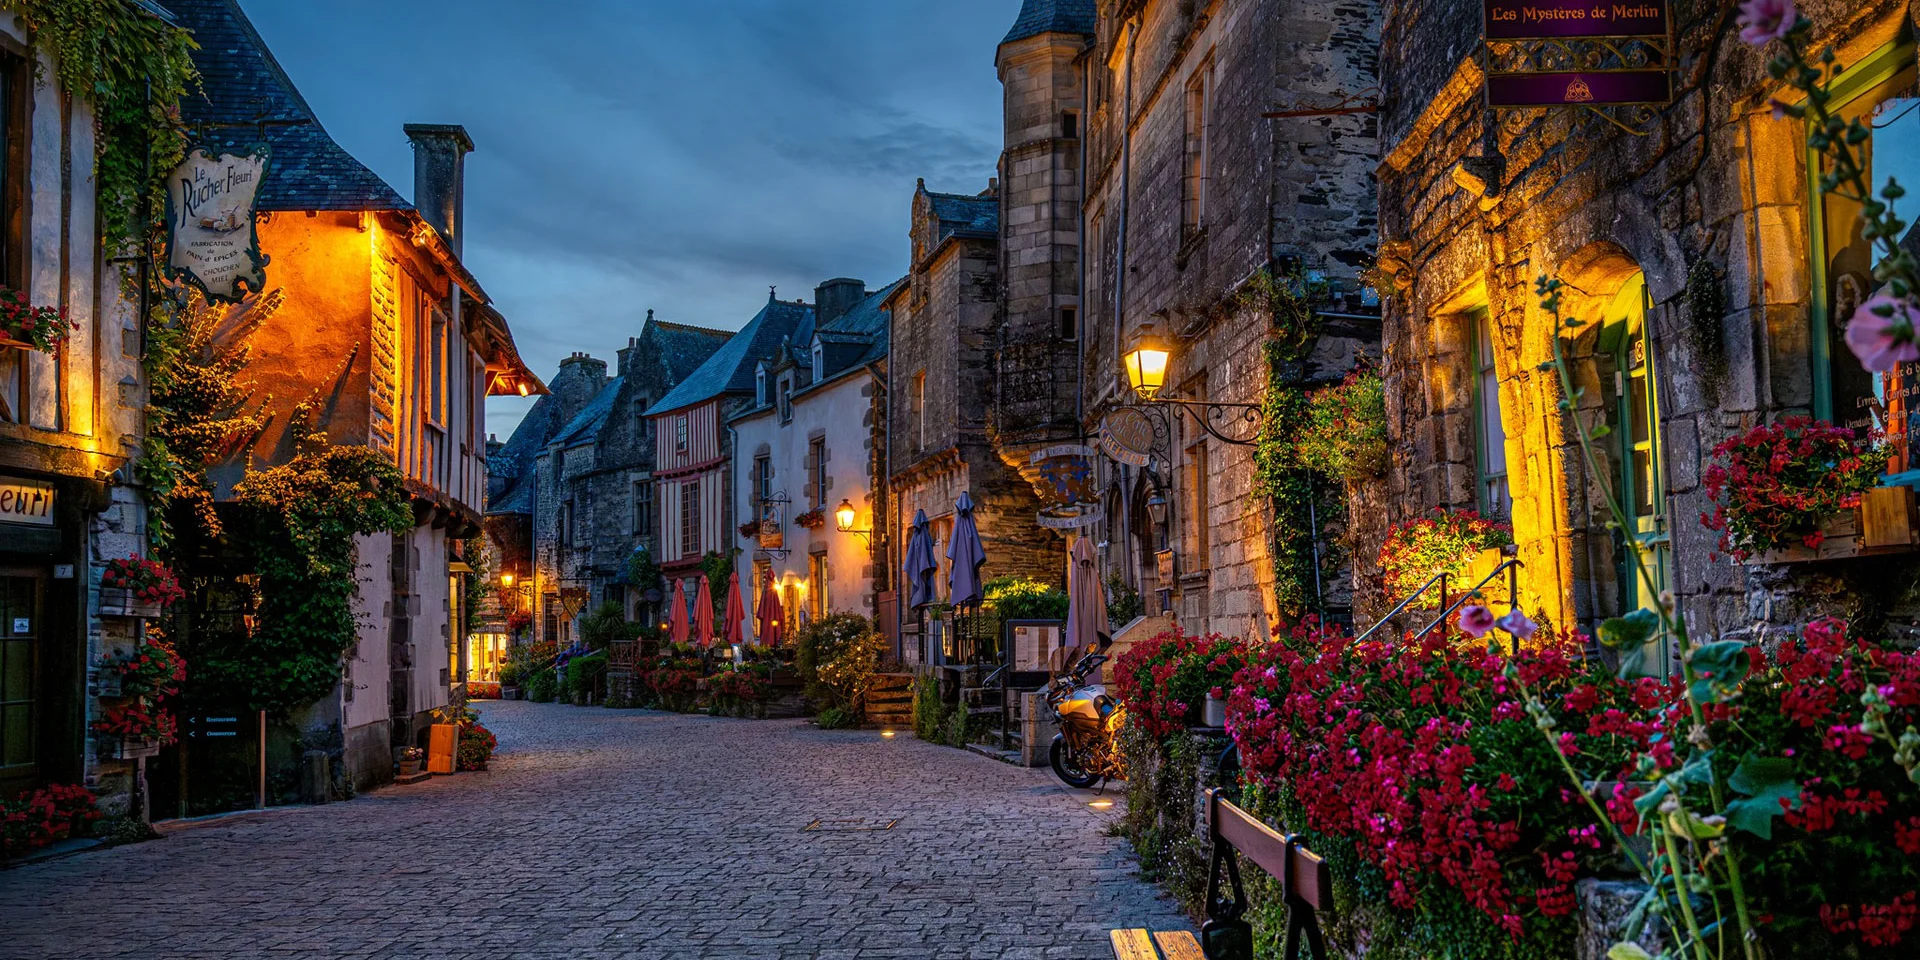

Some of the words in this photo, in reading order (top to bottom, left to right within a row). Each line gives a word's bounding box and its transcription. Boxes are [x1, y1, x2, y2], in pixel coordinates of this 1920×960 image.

[1492, 7, 1517, 21] Les
[1522, 6, 1586, 24] Mystères
[1591, 6, 1607, 19] de
[1612, 4, 1658, 22] Merlin
[194, 166, 206, 184] Le
[181, 176, 226, 229] Rucher
[226, 165, 253, 193] Fleuri
[190, 240, 234, 248] FABRICATION
[186, 250, 204, 262] PAIN
[203, 263, 241, 276] CHOUCHEN
[211, 275, 229, 285] MIEL
[60, 567, 67, 576] 7
